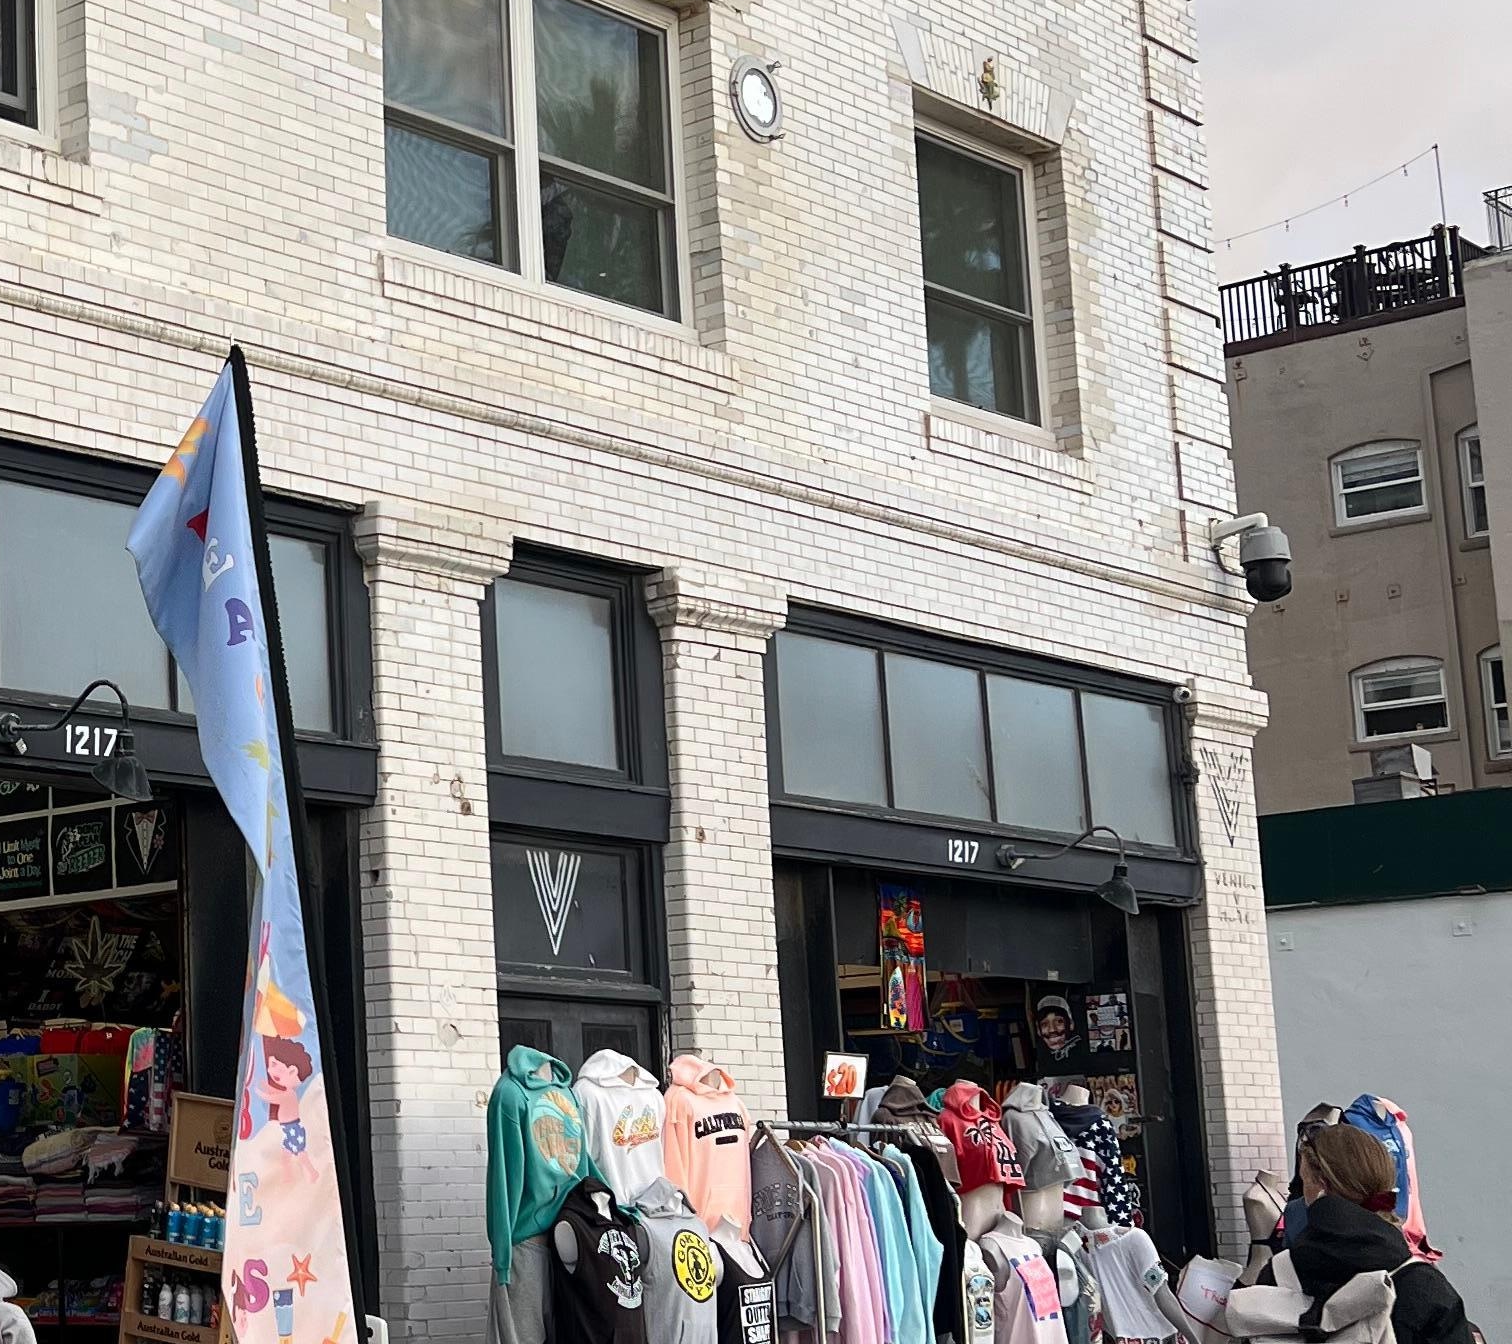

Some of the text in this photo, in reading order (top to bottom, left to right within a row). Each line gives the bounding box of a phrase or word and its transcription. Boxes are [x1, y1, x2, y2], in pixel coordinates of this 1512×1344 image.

[65, 724, 117, 757] 1217
[948, 839, 979, 864] 1217
[195, 1141, 229, 1159] Austra
[208, 1157, 229, 1171] Gol
[145, 1245, 188, 1264] Australian
[137, 1321, 180, 1339] Australian
